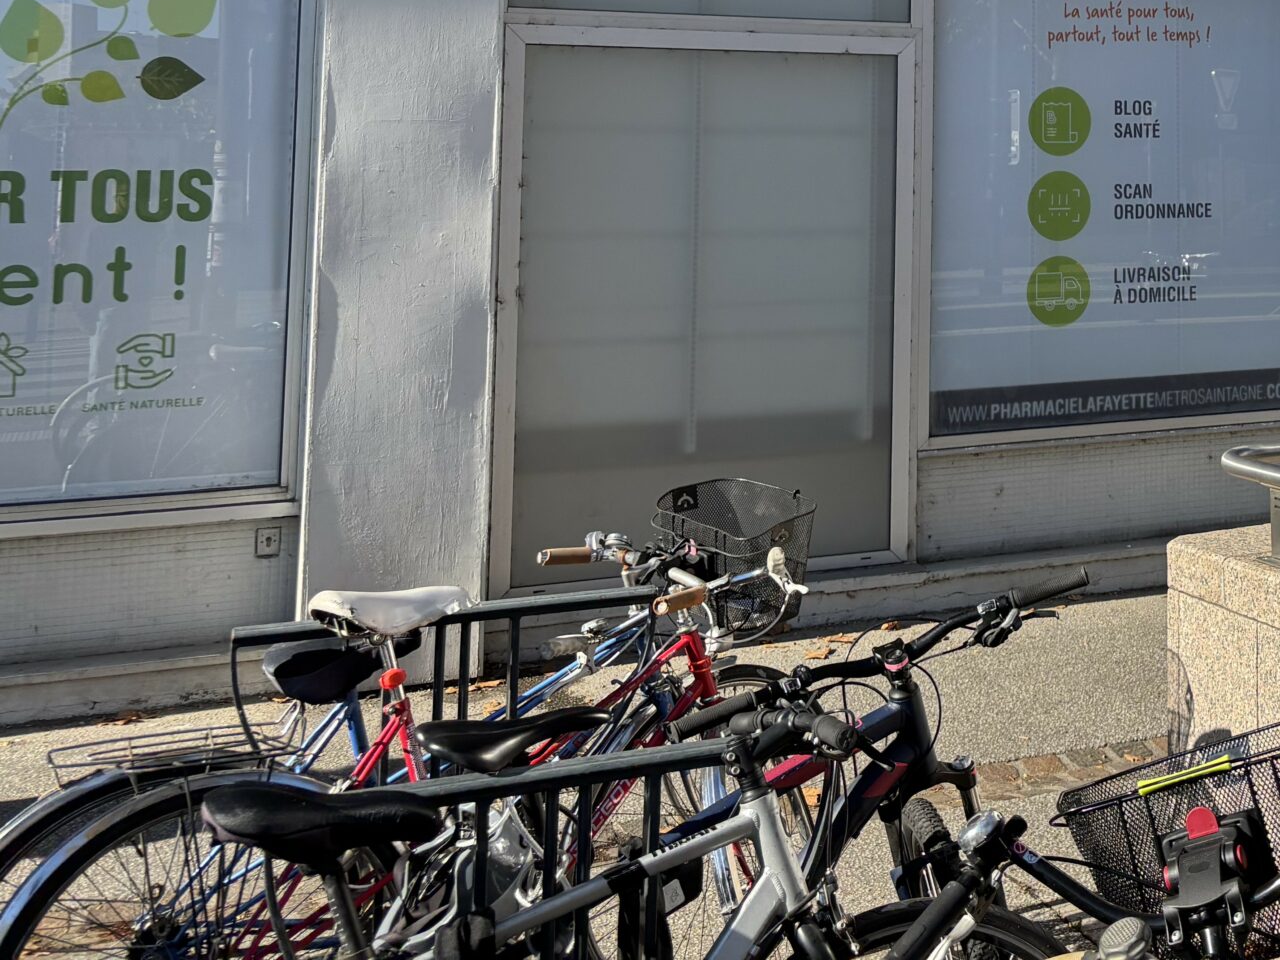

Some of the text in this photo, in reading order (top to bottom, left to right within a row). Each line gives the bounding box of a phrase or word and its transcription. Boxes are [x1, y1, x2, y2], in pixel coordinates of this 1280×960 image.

[1064, 0, 1195, 25] La santé pour tous,
[1047, 25, 1106, 49] partout,
[1111, 25, 1141, 42] tout
[1146, 27, 1158, 42] le
[1162, 26, 1201, 48] temps
[1114, 100, 1152, 116] BLOG
[1114, 119, 1160, 138] SANTÉ
[50, 168, 213, 224] TOUS
[1114, 183, 1152, 200] SCAN
[1114, 203, 1212, 220] ORDONNANCE
[1114, 266, 1191, 284] LIVRAISON
[1113, 285, 1197, 305] À DOMICILE
[81, 397, 126, 414] SANTÉ
[130, 396, 205, 411] NATURELLE
